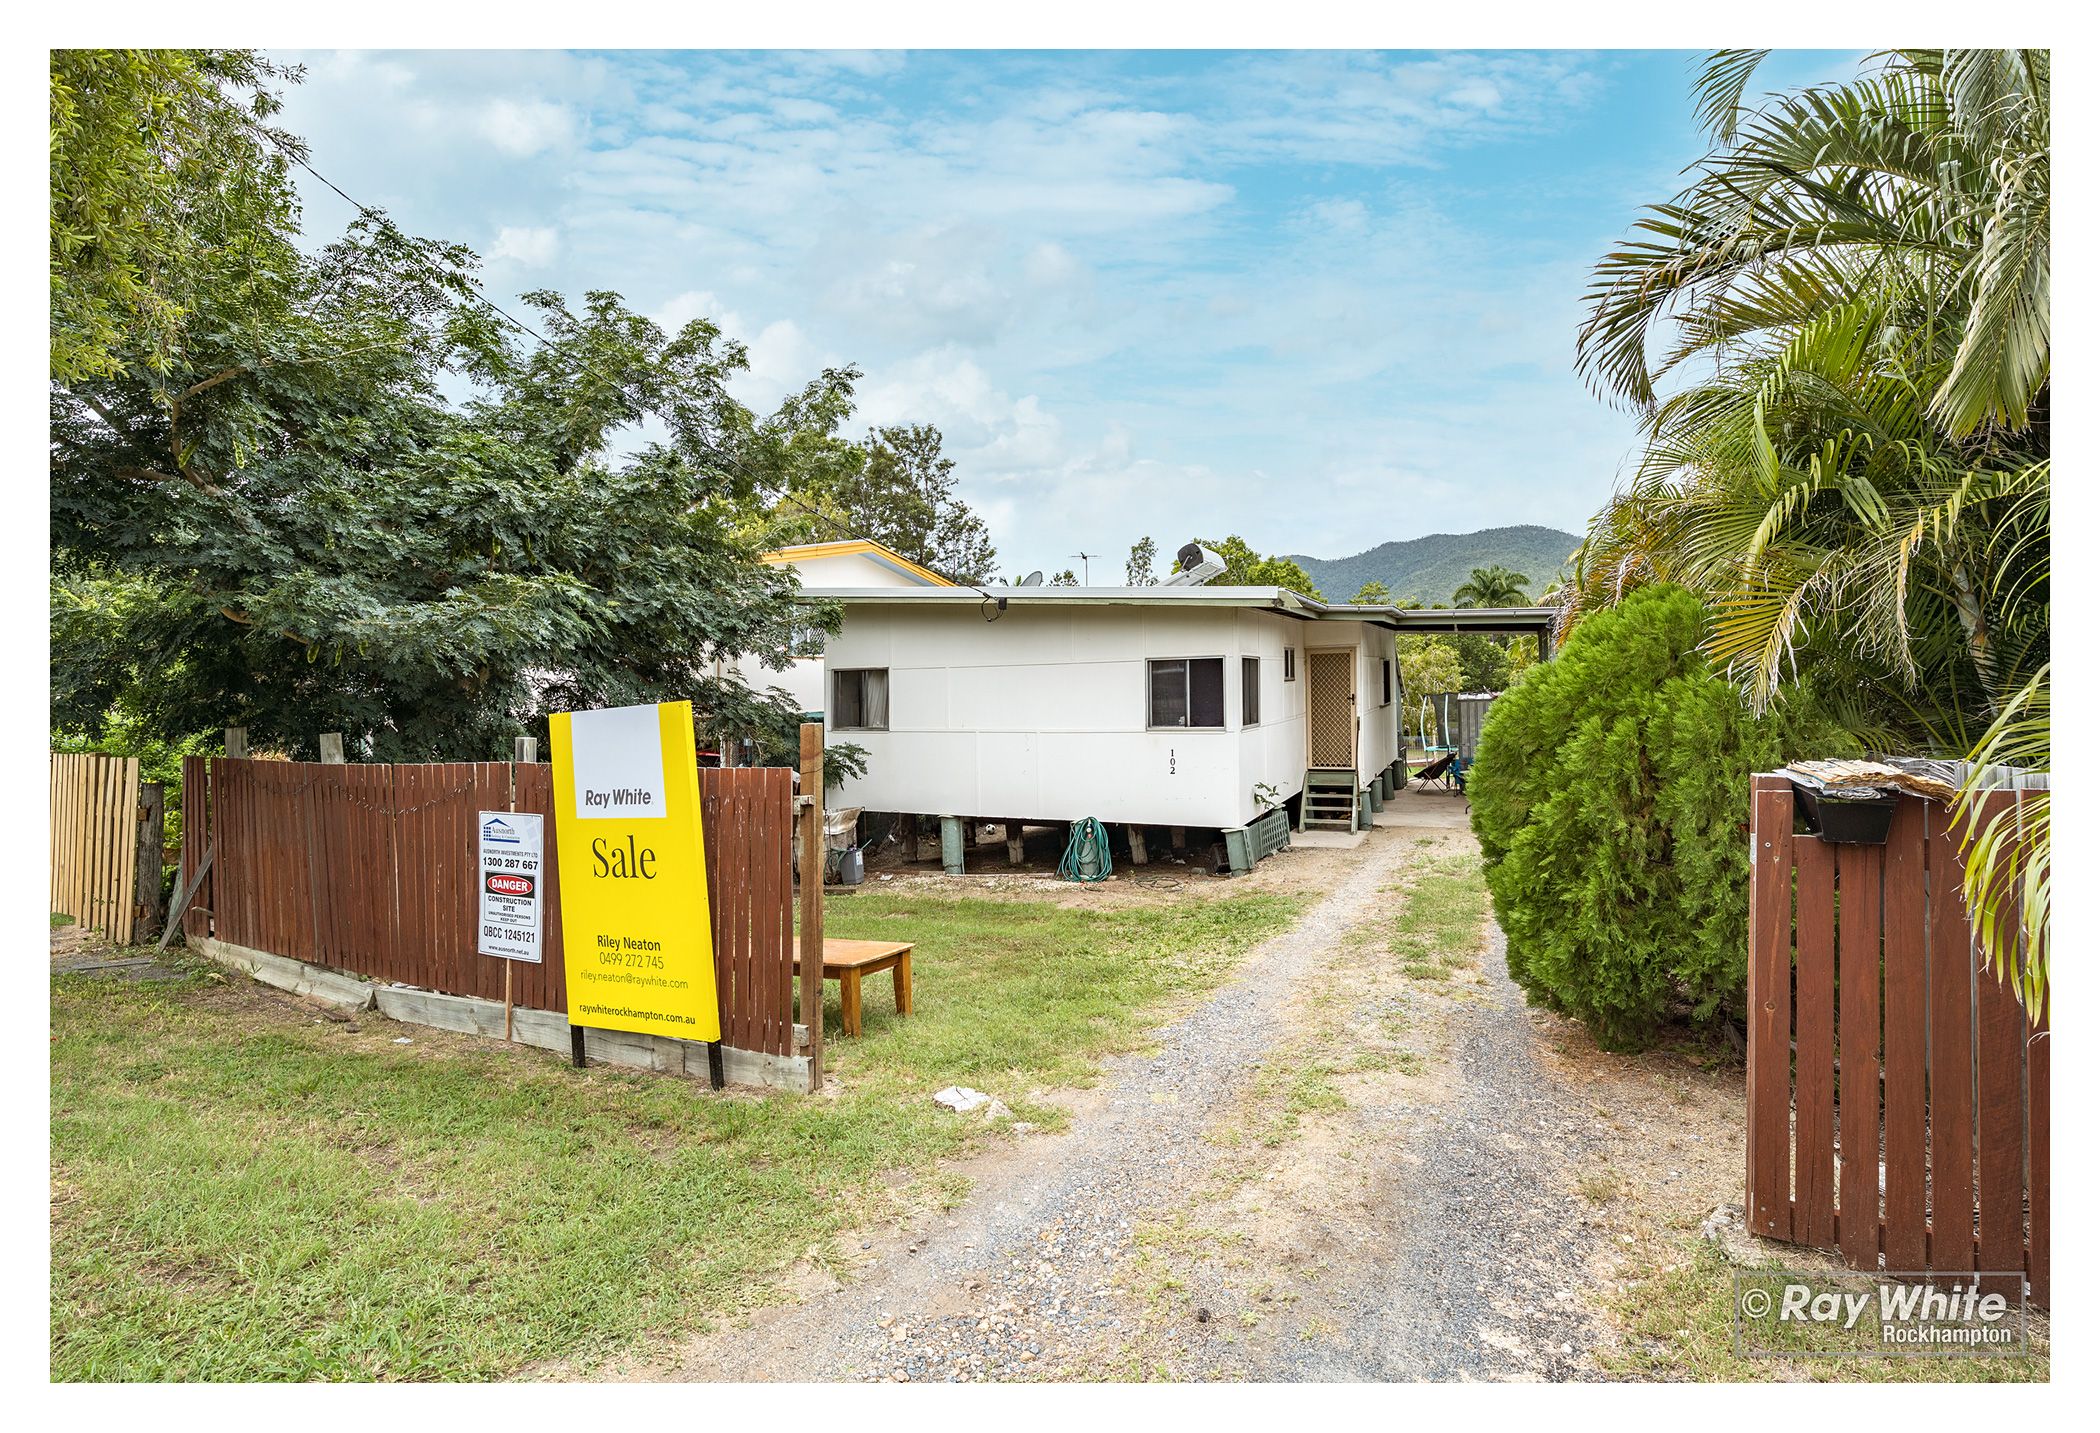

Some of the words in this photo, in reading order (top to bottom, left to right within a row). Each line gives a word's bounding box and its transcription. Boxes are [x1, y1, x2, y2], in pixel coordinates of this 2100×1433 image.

[585, 789, 610, 809] Ray
[612, 788, 652, 806] White
[483, 856, 502, 867] 1300
[504, 858, 520, 869] 287
[522, 860, 539, 870] 667
[591, 834, 657, 880] Sale
[491, 878, 528, 892] DANGER
[487, 895, 532, 906] CONSTRUCTION
[502, 904, 516, 913] SITE
[483, 925, 503, 939] QBCC
[504, 928, 535, 943] 1245121
[597, 934, 621, 951] Riley
[623, 936, 661, 951] Neaton
[488, 945, 530, 956] www.ausnorth.net.au
[599, 951, 623, 966] 0499
[625, 953, 644, 968] 272
[645, 955, 665, 970] 745
[580, 969, 689, 989] riley.neaton@raywhite.com
[579, 1003, 696, 1025] raywhiterockhampton.com.au
